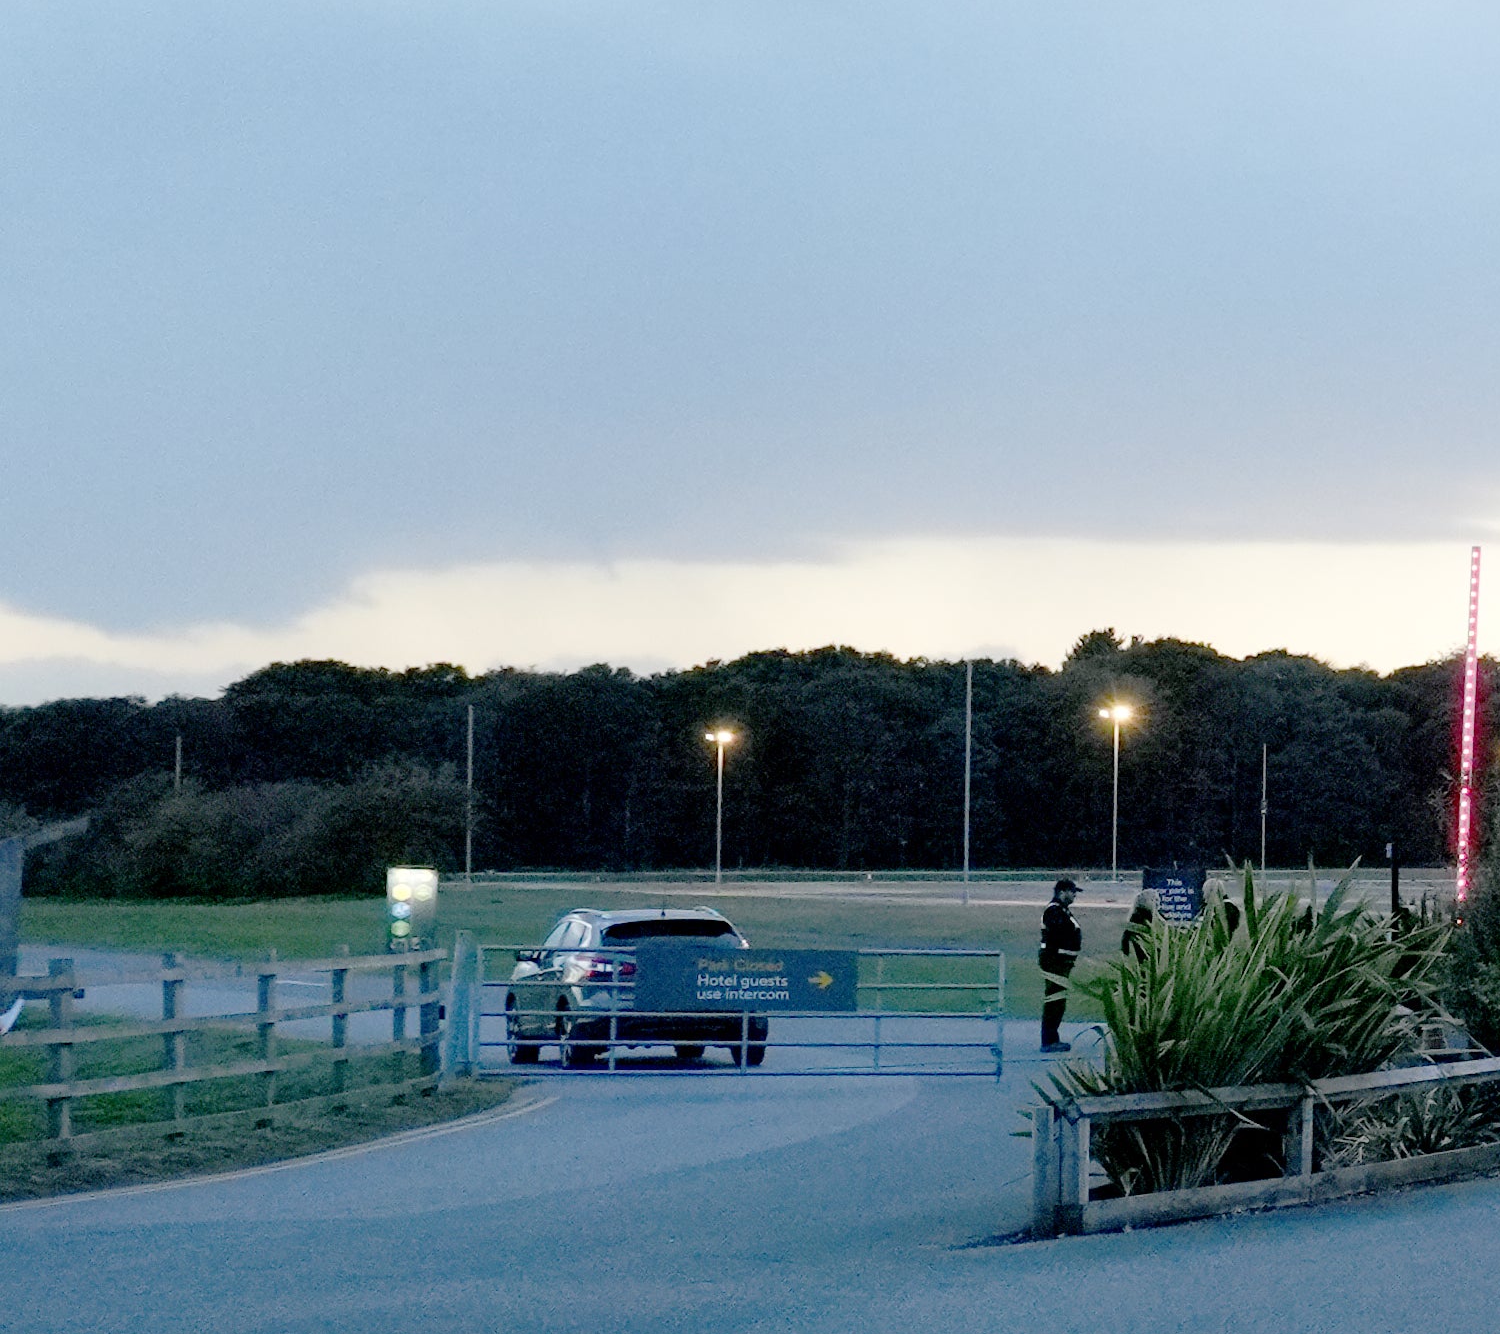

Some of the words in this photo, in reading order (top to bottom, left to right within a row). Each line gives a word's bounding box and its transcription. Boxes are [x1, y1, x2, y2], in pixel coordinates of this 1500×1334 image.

[1166, 878, 1182, 886] This
[697, 973, 738, 987] Hotel
[740, 975, 788, 989] guests
[697, 990, 722, 1000] use
[725, 988, 790, 1000] intercom
